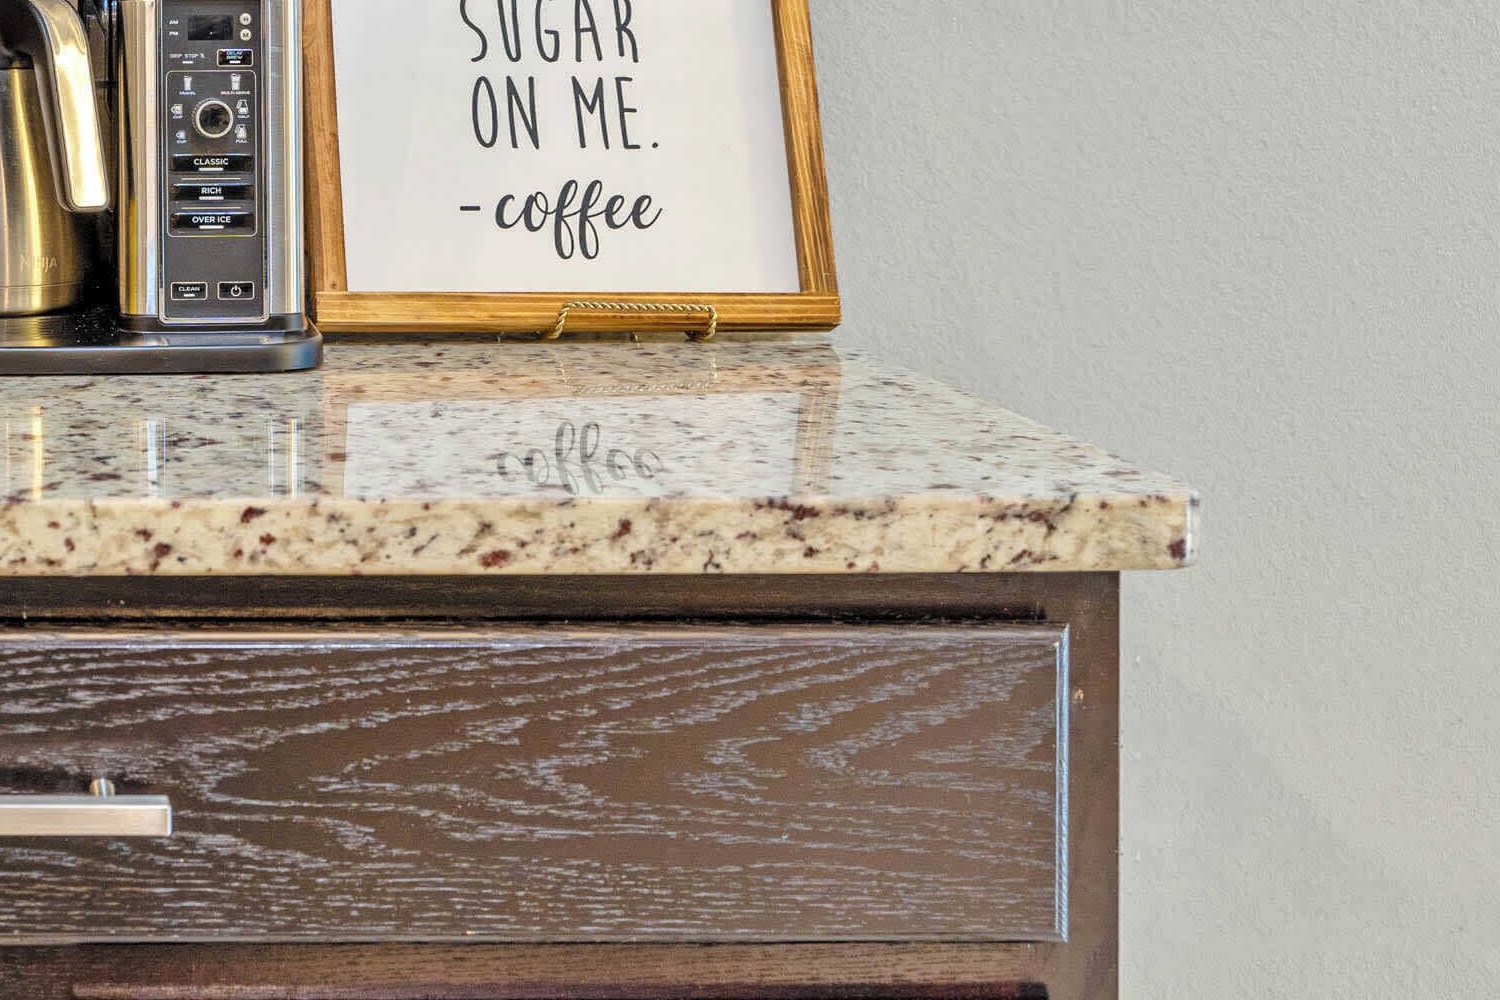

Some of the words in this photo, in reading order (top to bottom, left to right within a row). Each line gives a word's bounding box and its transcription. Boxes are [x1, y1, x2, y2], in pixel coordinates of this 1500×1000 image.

[471, 75, 540, 150] ON
[571, 75, 659, 150] ME.
[193, 158, 229, 166] CLASSIC
[201, 187, 222, 195] RICH
